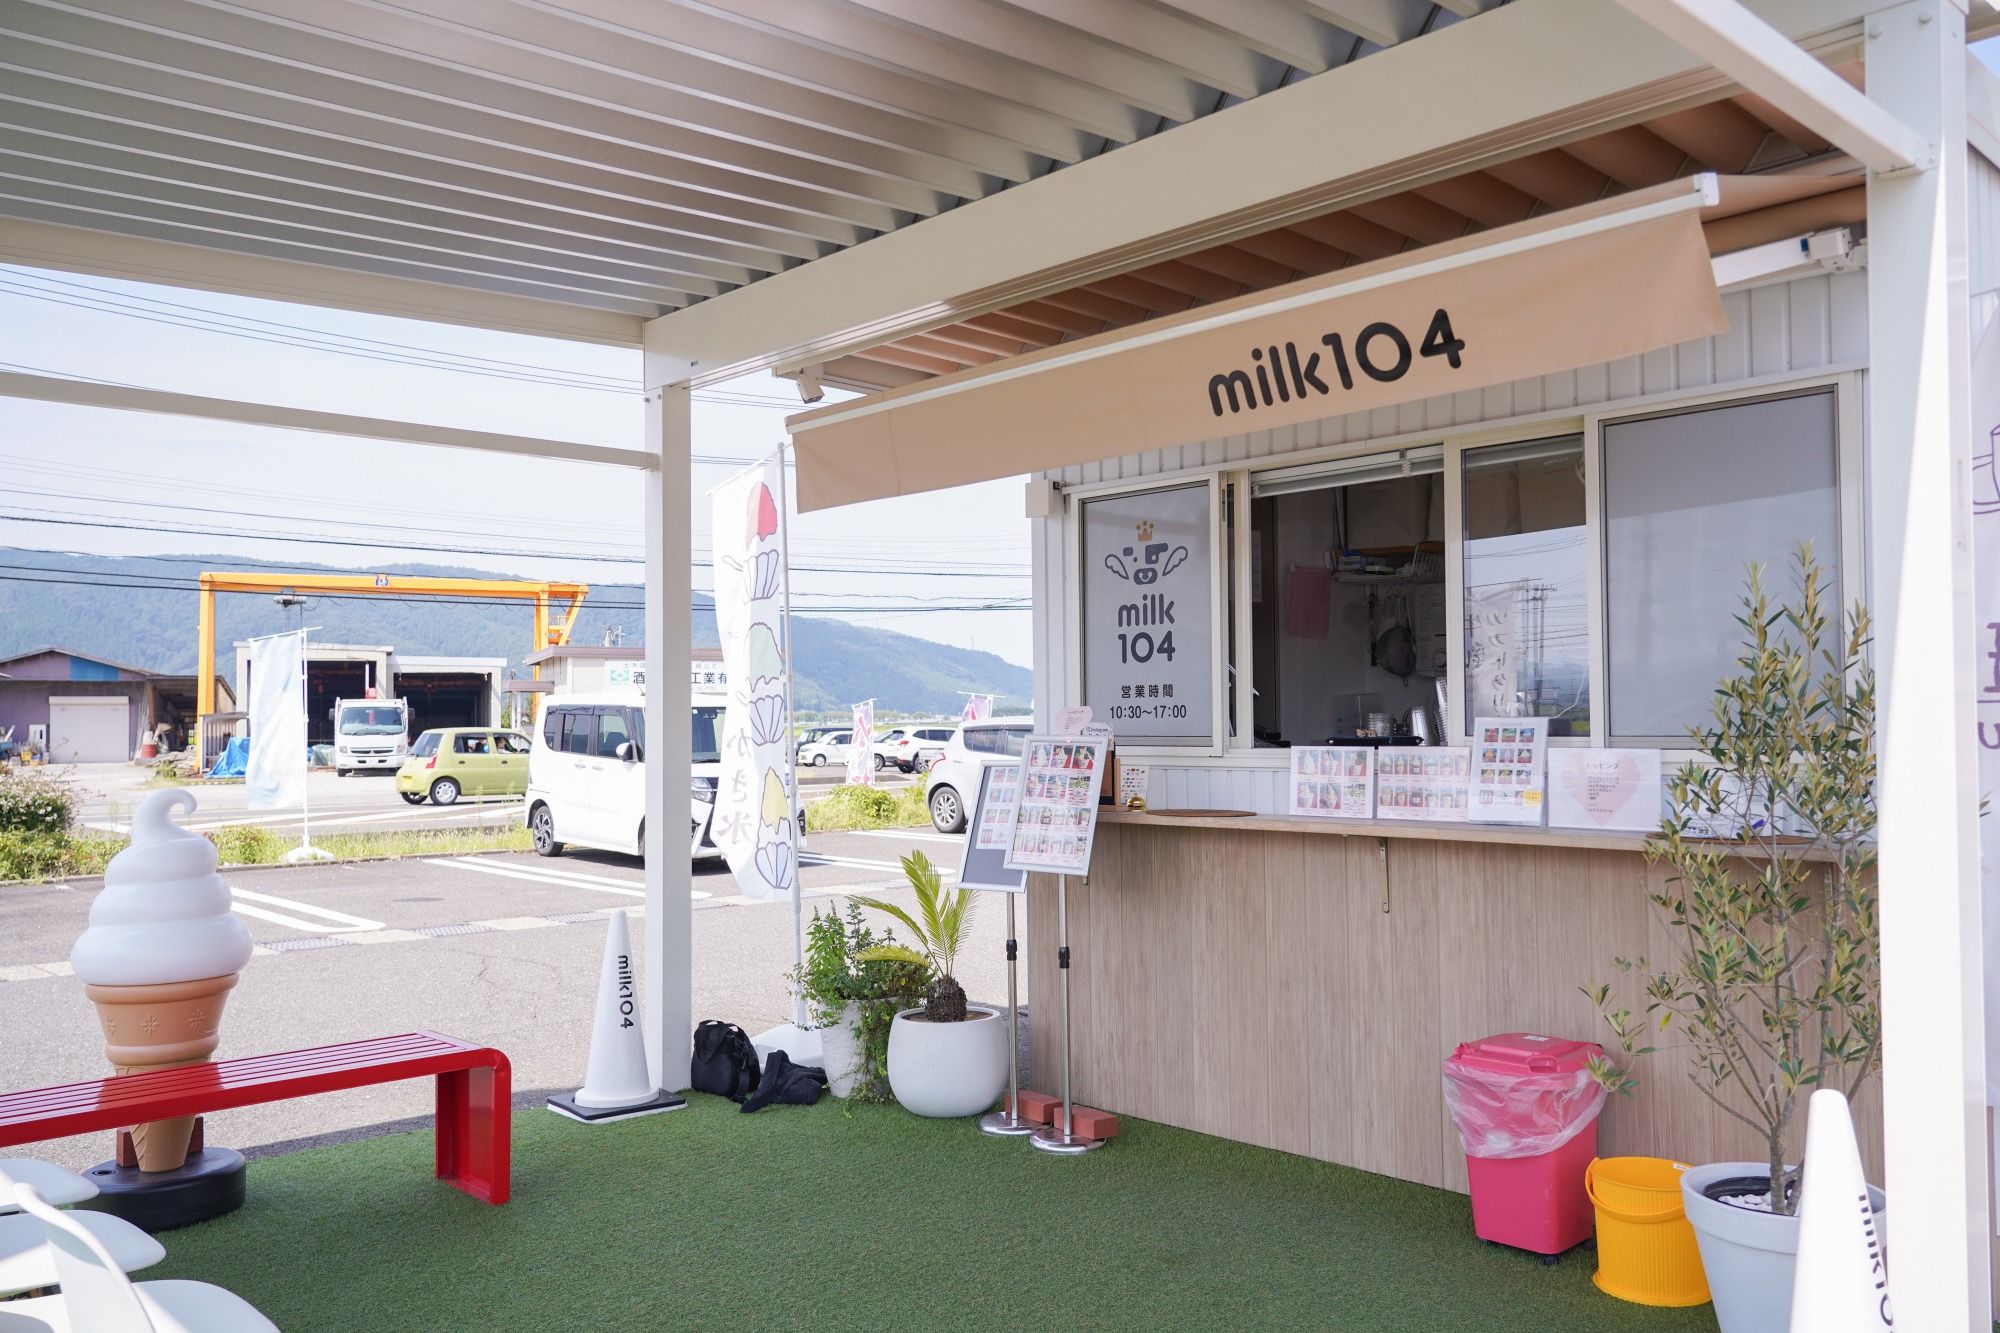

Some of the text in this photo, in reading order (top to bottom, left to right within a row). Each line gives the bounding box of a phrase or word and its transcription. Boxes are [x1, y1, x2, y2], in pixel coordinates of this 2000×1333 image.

[1208, 307, 1466, 417] milk104
[1117, 593, 1175, 628] milk
[1117, 630, 1176, 664] 104
[1121, 684, 1174, 699] 営業時間
[617, 954, 634, 1029] milk104
